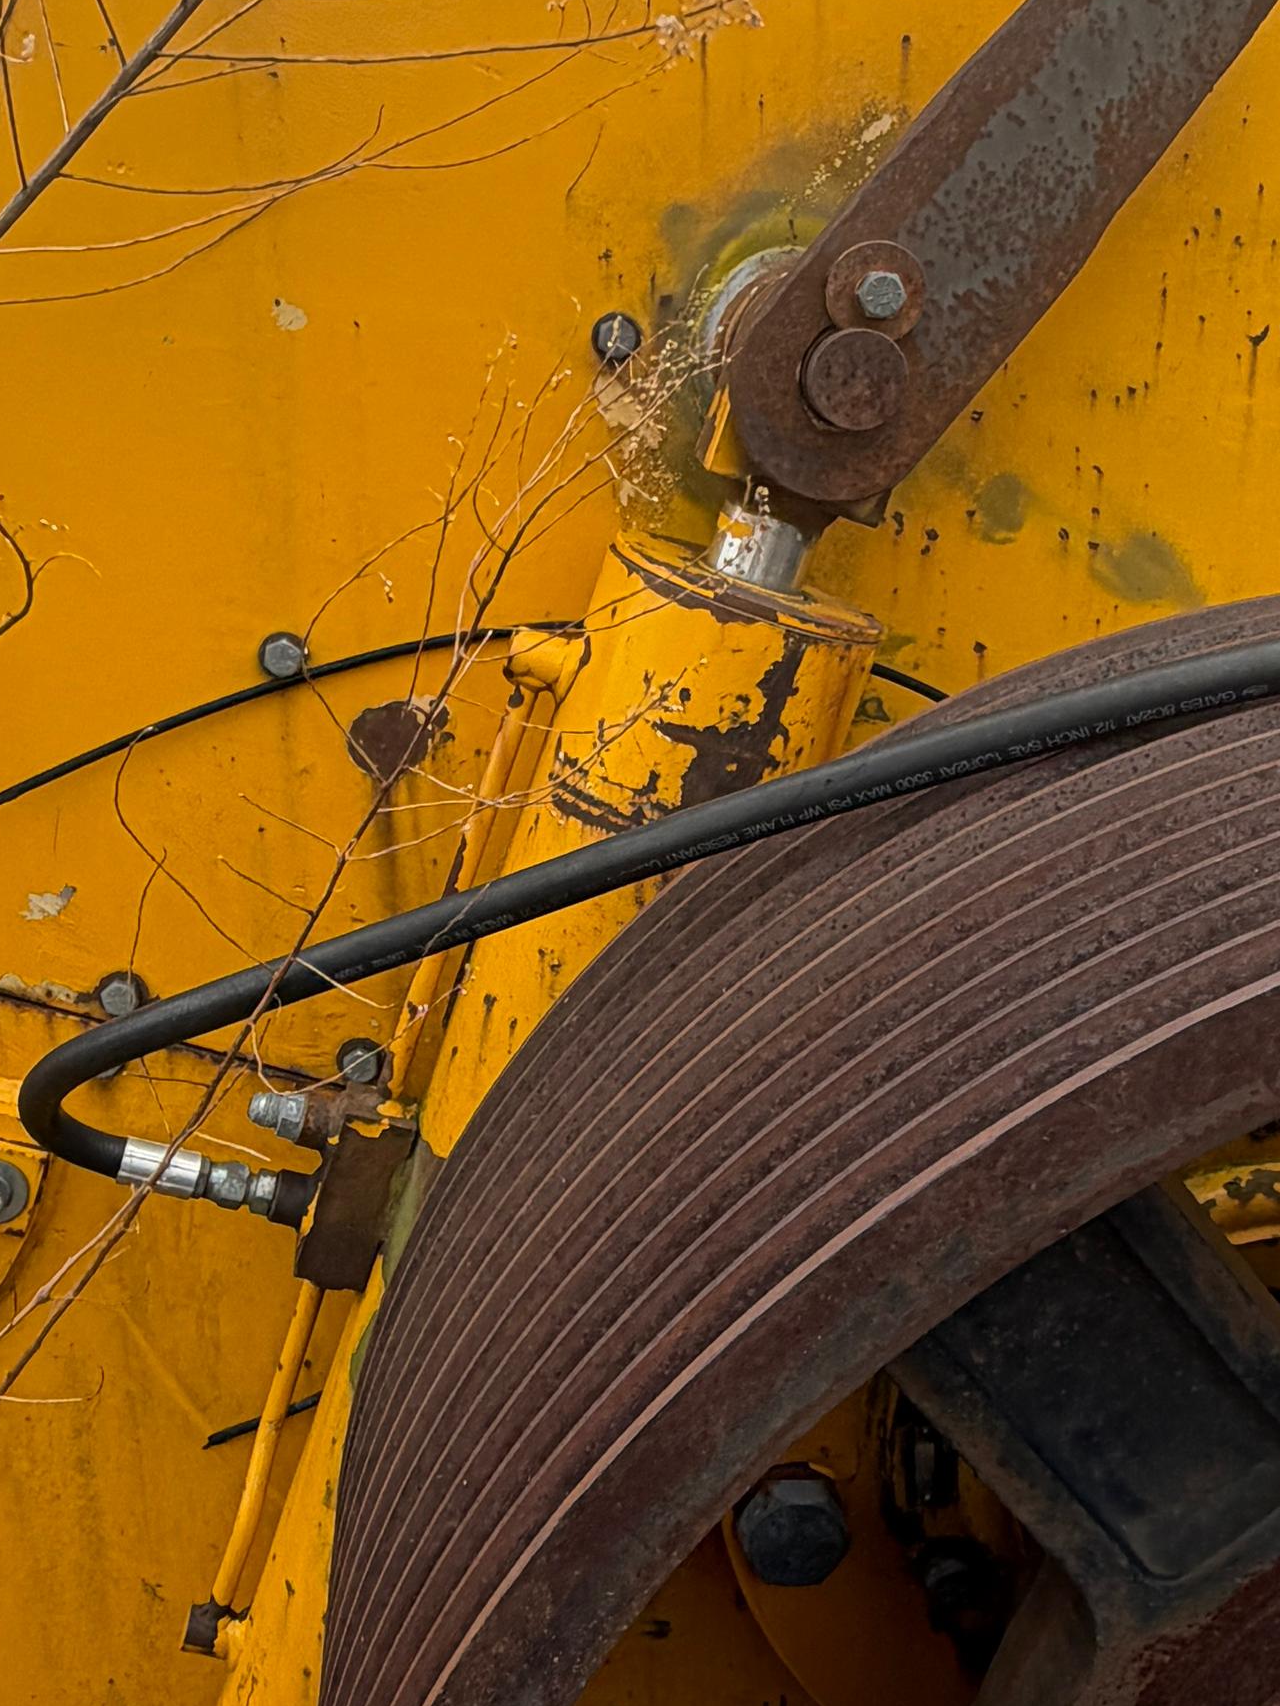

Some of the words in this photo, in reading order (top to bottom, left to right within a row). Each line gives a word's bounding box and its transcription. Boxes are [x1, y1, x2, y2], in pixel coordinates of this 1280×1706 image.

[1178, 689, 1237, 713] GATES
[1045, 724, 1091, 748] INCH
[1006, 737, 1043, 759] SAE
[825, 793, 853, 812] PSI
[853, 781, 893, 803] MAX
[796, 802, 825, 821] WP
